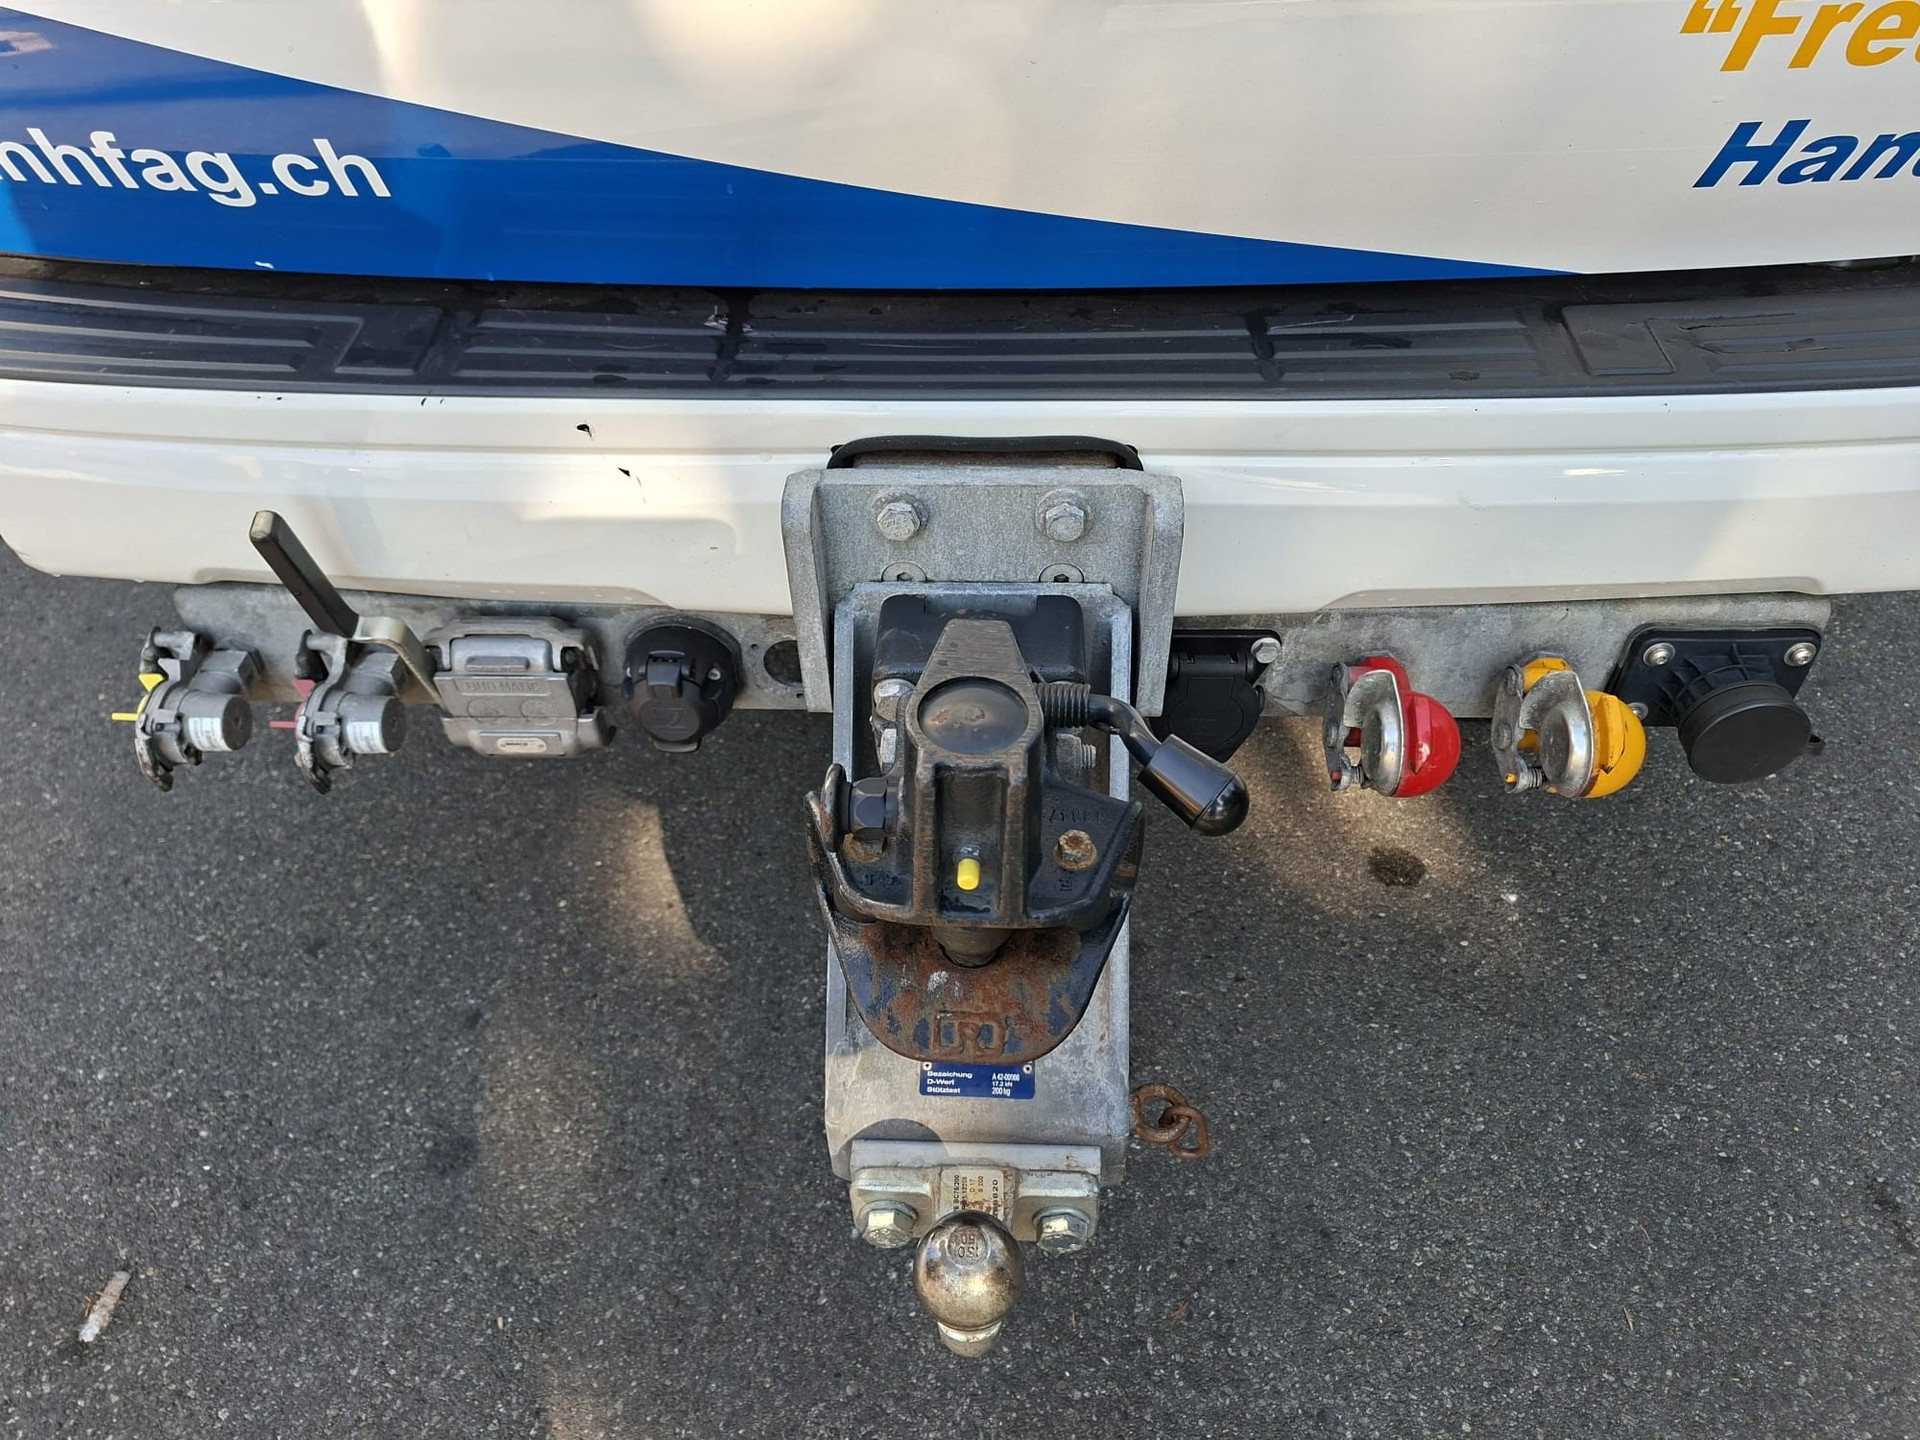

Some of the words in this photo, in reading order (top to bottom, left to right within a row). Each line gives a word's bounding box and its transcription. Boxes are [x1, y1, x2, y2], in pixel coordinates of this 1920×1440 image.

[1679, 0, 1920, 72] “Fre
[1691, 118, 1920, 189] Han
[927, 1086, 961, 1094] Stützlast
[992, 1087, 1003, 1095] 200
[1003, 1087, 1011, 1097] kg
